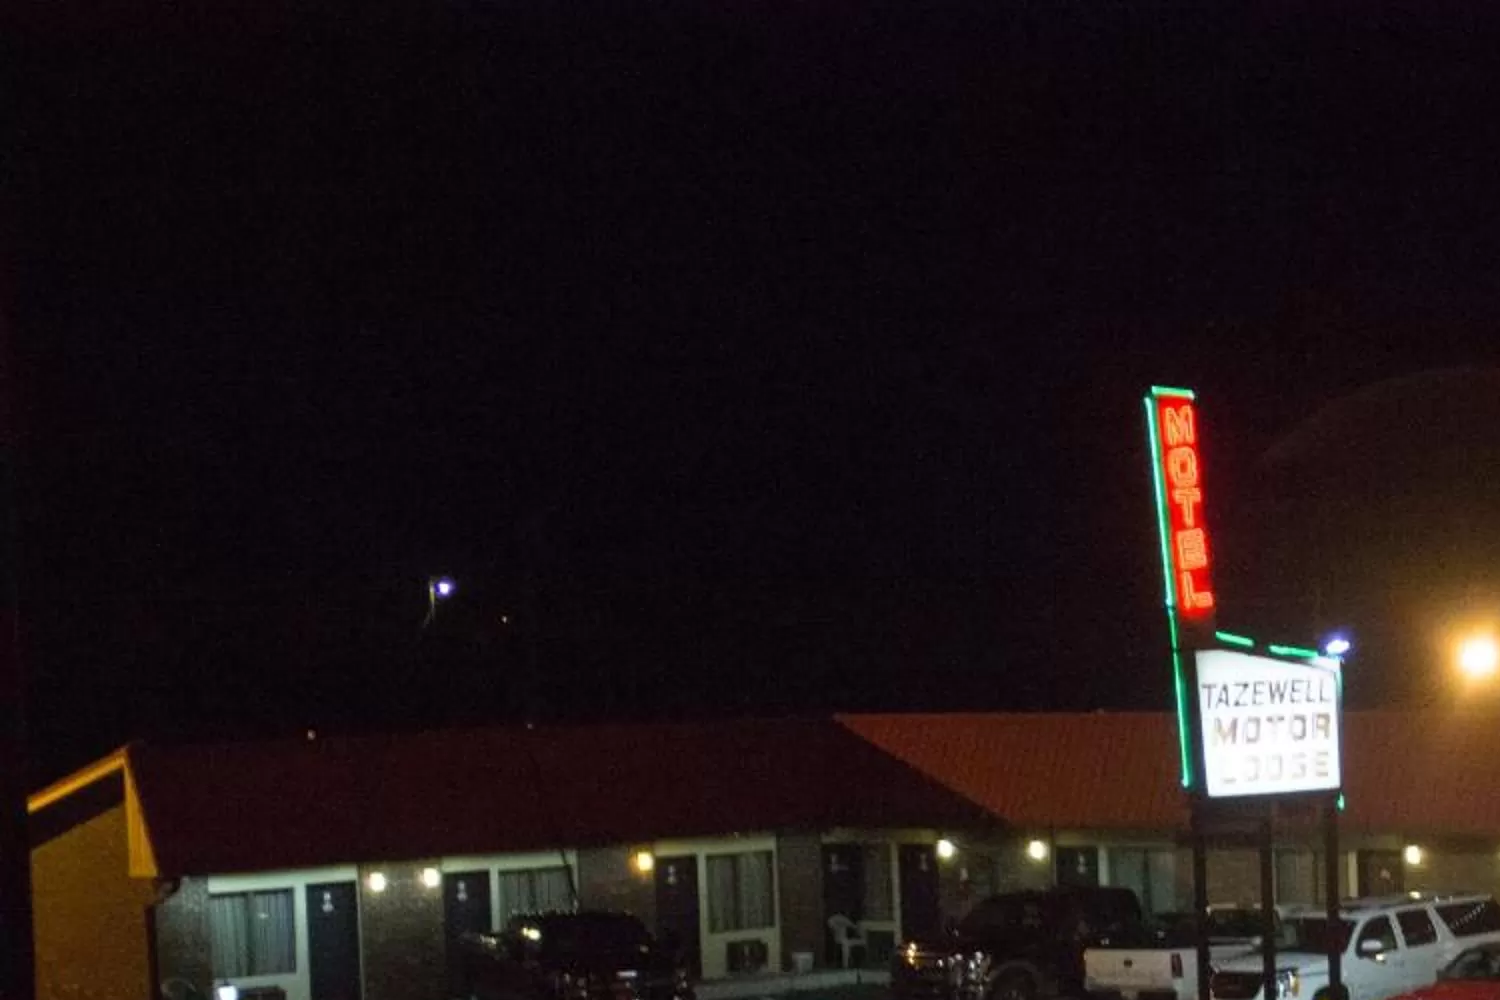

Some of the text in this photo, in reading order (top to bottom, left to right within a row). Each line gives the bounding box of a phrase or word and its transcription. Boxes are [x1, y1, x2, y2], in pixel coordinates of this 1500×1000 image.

[1162, 405, 1213, 609] MOTEL
[1201, 678, 1333, 709] TAZEWELL
[1213, 713, 1331, 745] MOTOR
